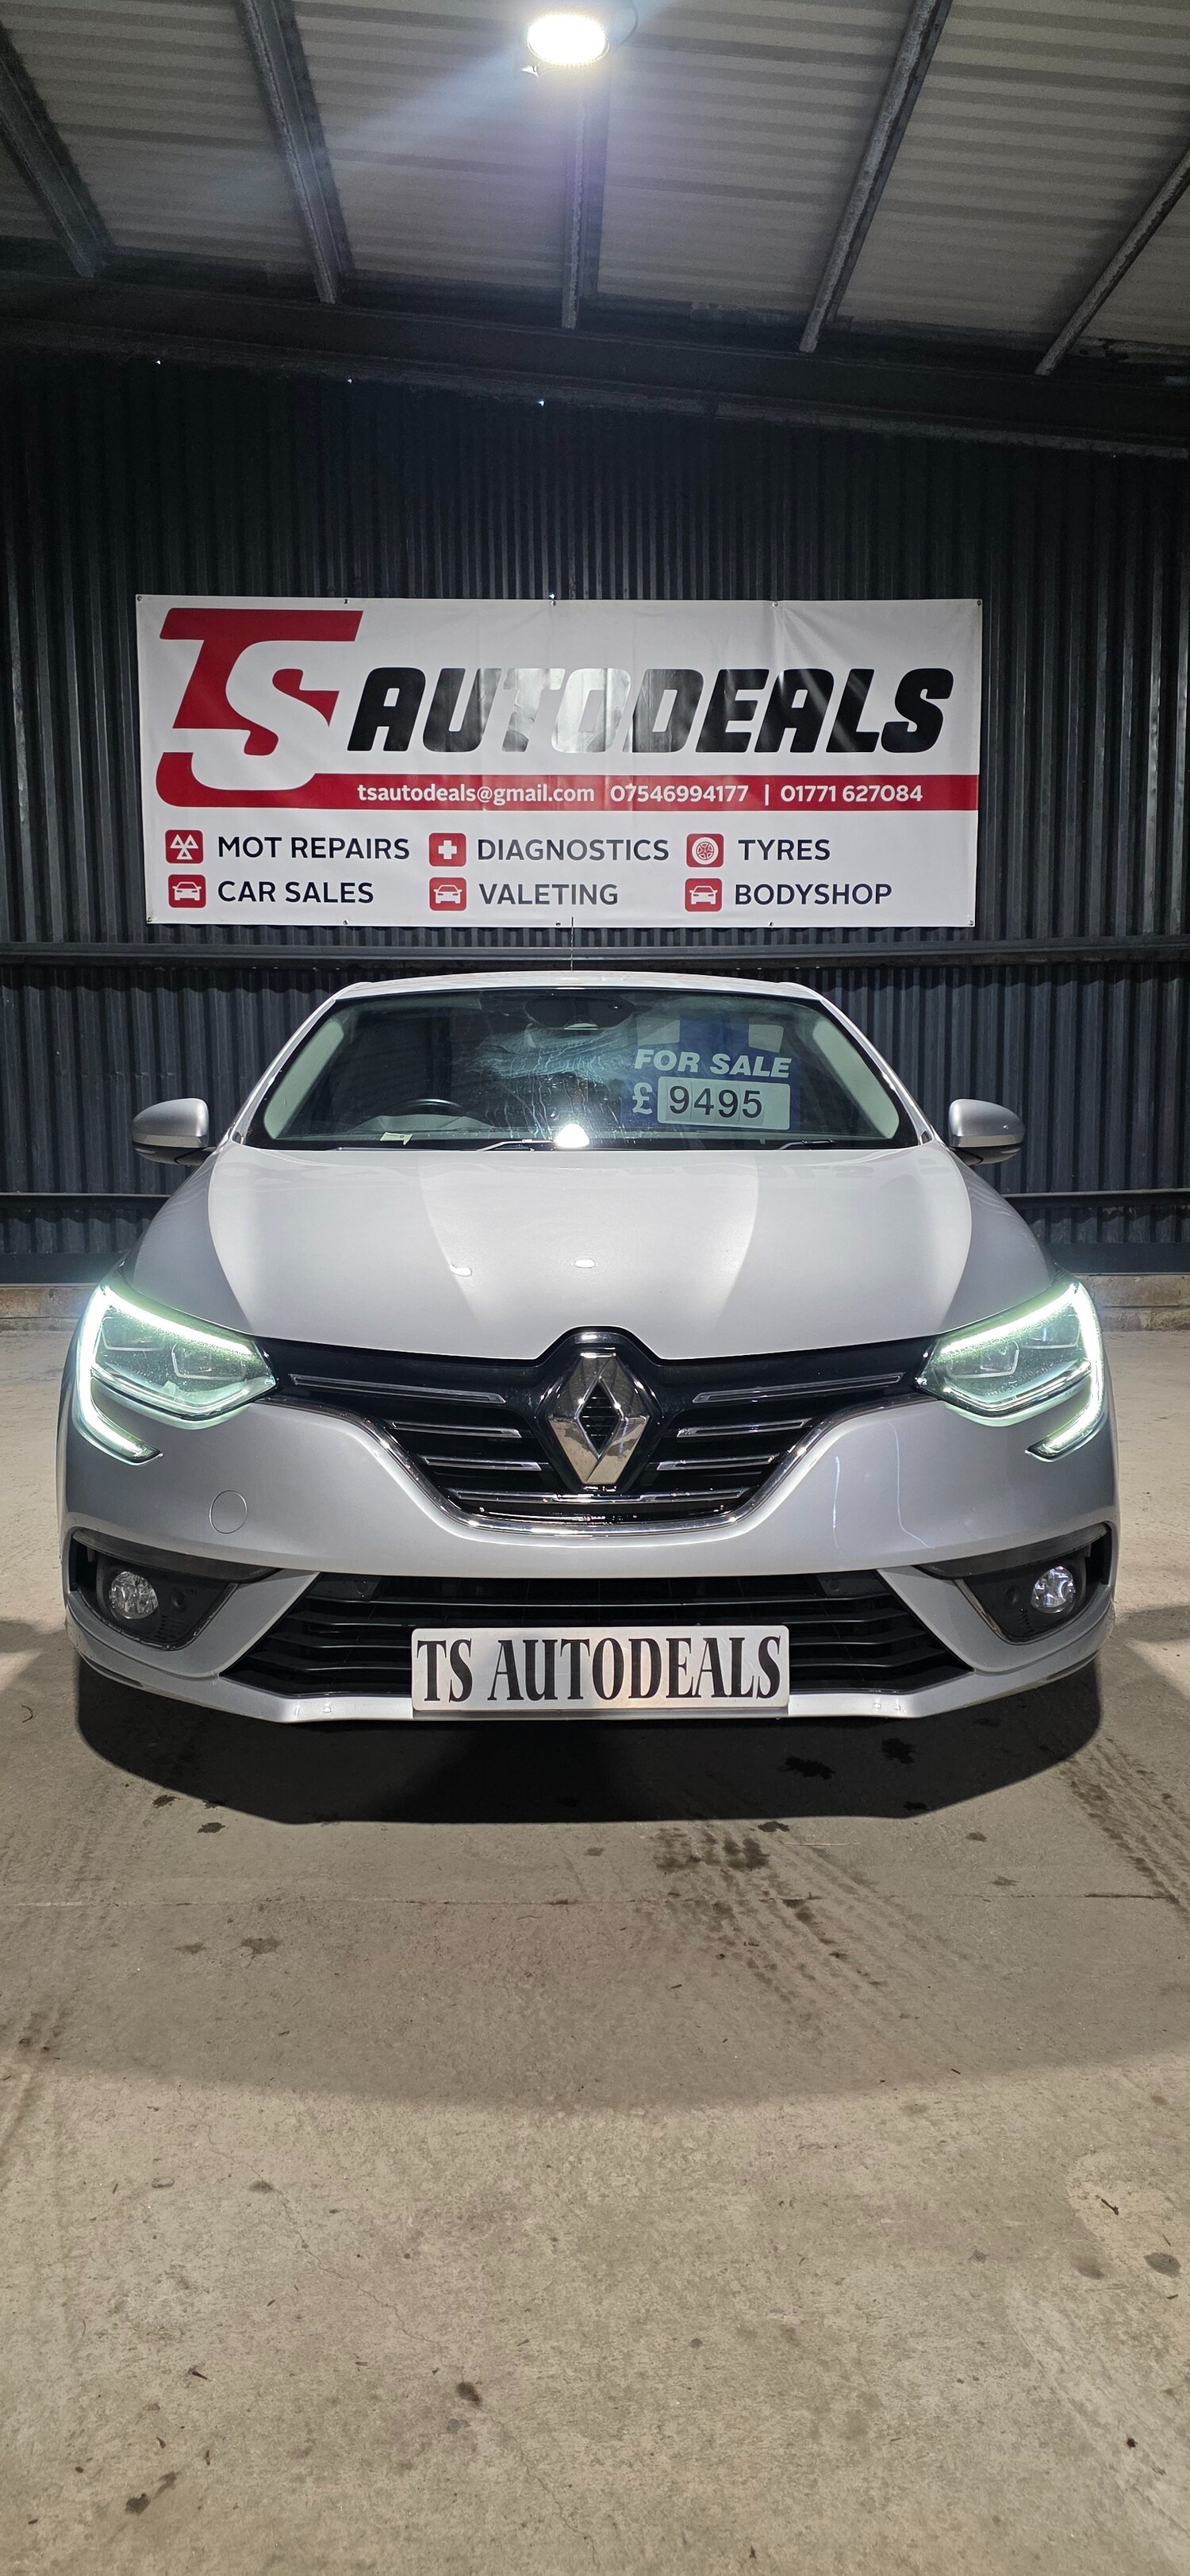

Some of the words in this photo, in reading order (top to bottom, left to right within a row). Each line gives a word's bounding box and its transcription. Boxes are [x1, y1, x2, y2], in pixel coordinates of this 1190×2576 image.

[158, 607, 364, 792] TS
[347, 666, 954, 754] AUTODEALS
[357, 783, 595, 806] tsautodeals@gmail.com
[610, 784, 749, 803] 07546994177
[780, 784, 837, 803] 01771
[842, 784, 923, 803] 627084
[217, 835, 282, 859] MOT
[290, 836, 410, 860] REPAIRS
[477, 838, 670, 862] DIAGNOSTICS
[738, 839, 831, 862] TYRES
[217, 880, 276, 903] CAR
[285, 881, 374, 904] SALES
[478, 883, 618, 906] VALETING
[735, 883, 892, 906] BODYSHOP
[634, 1048, 701, 1073] FOR
[709, 1053, 793, 1078] SALE
[669, 1085, 763, 1119] 9495
[416, 1638, 474, 1703] TS
[487, 1635, 782, 1702] AUTODEALS
